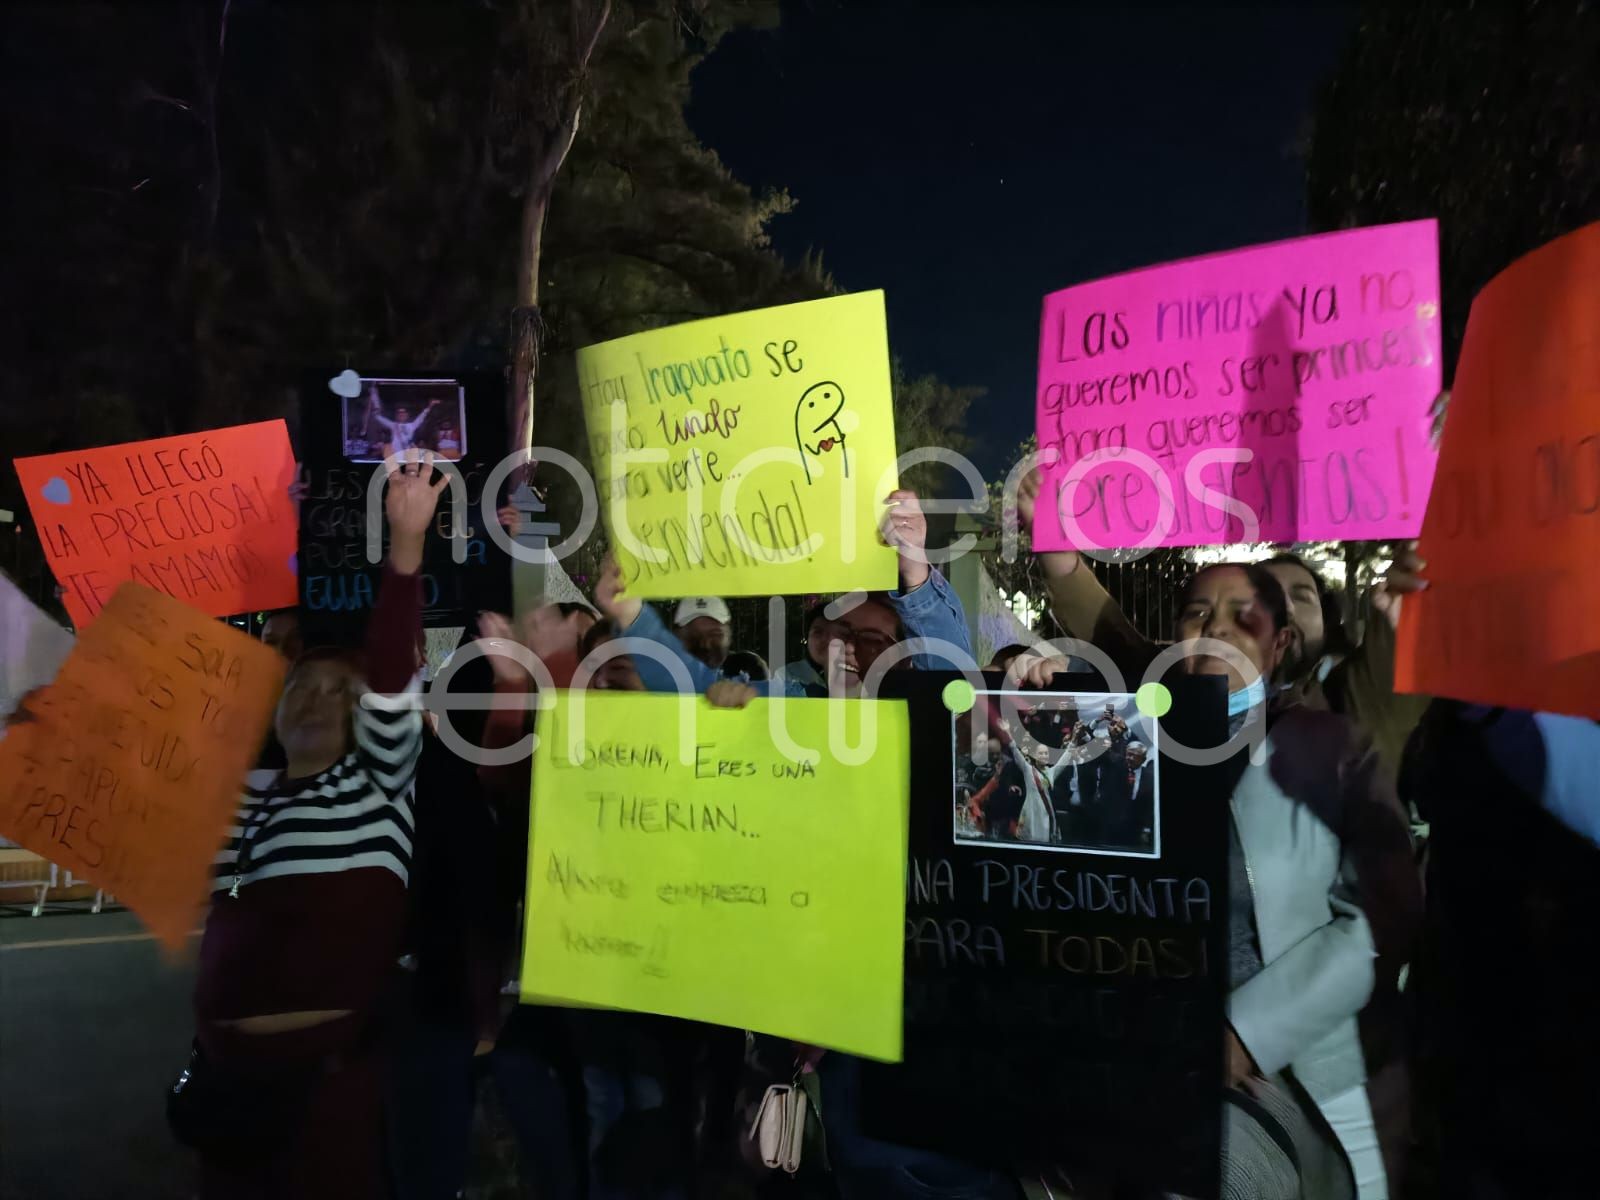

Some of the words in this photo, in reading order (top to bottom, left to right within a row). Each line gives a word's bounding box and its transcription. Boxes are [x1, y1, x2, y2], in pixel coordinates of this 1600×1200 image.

[1056, 309, 1130, 363] Las
[1282, 282, 1339, 340] ya
[1360, 269, 1415, 315] no
[636, 336, 752, 405] Irapuato
[764, 339, 803, 378] se
[1041, 359, 1197, 415] queremos
[1218, 352, 1279, 396] ser
[1147, 404, 1302, 470] queremos
[1326, 392, 1375, 429] ser
[65, 461, 112, 505] YA
[125, 439, 223, 496] LLEGÓ
[43, 524, 79, 558] LA
[90, 476, 277, 557] PRECIOSA!
[772, 759, 815, 779] UNA
[906, 856, 956, 905] NA
[973, 858, 1212, 924] PRESIDENTA
